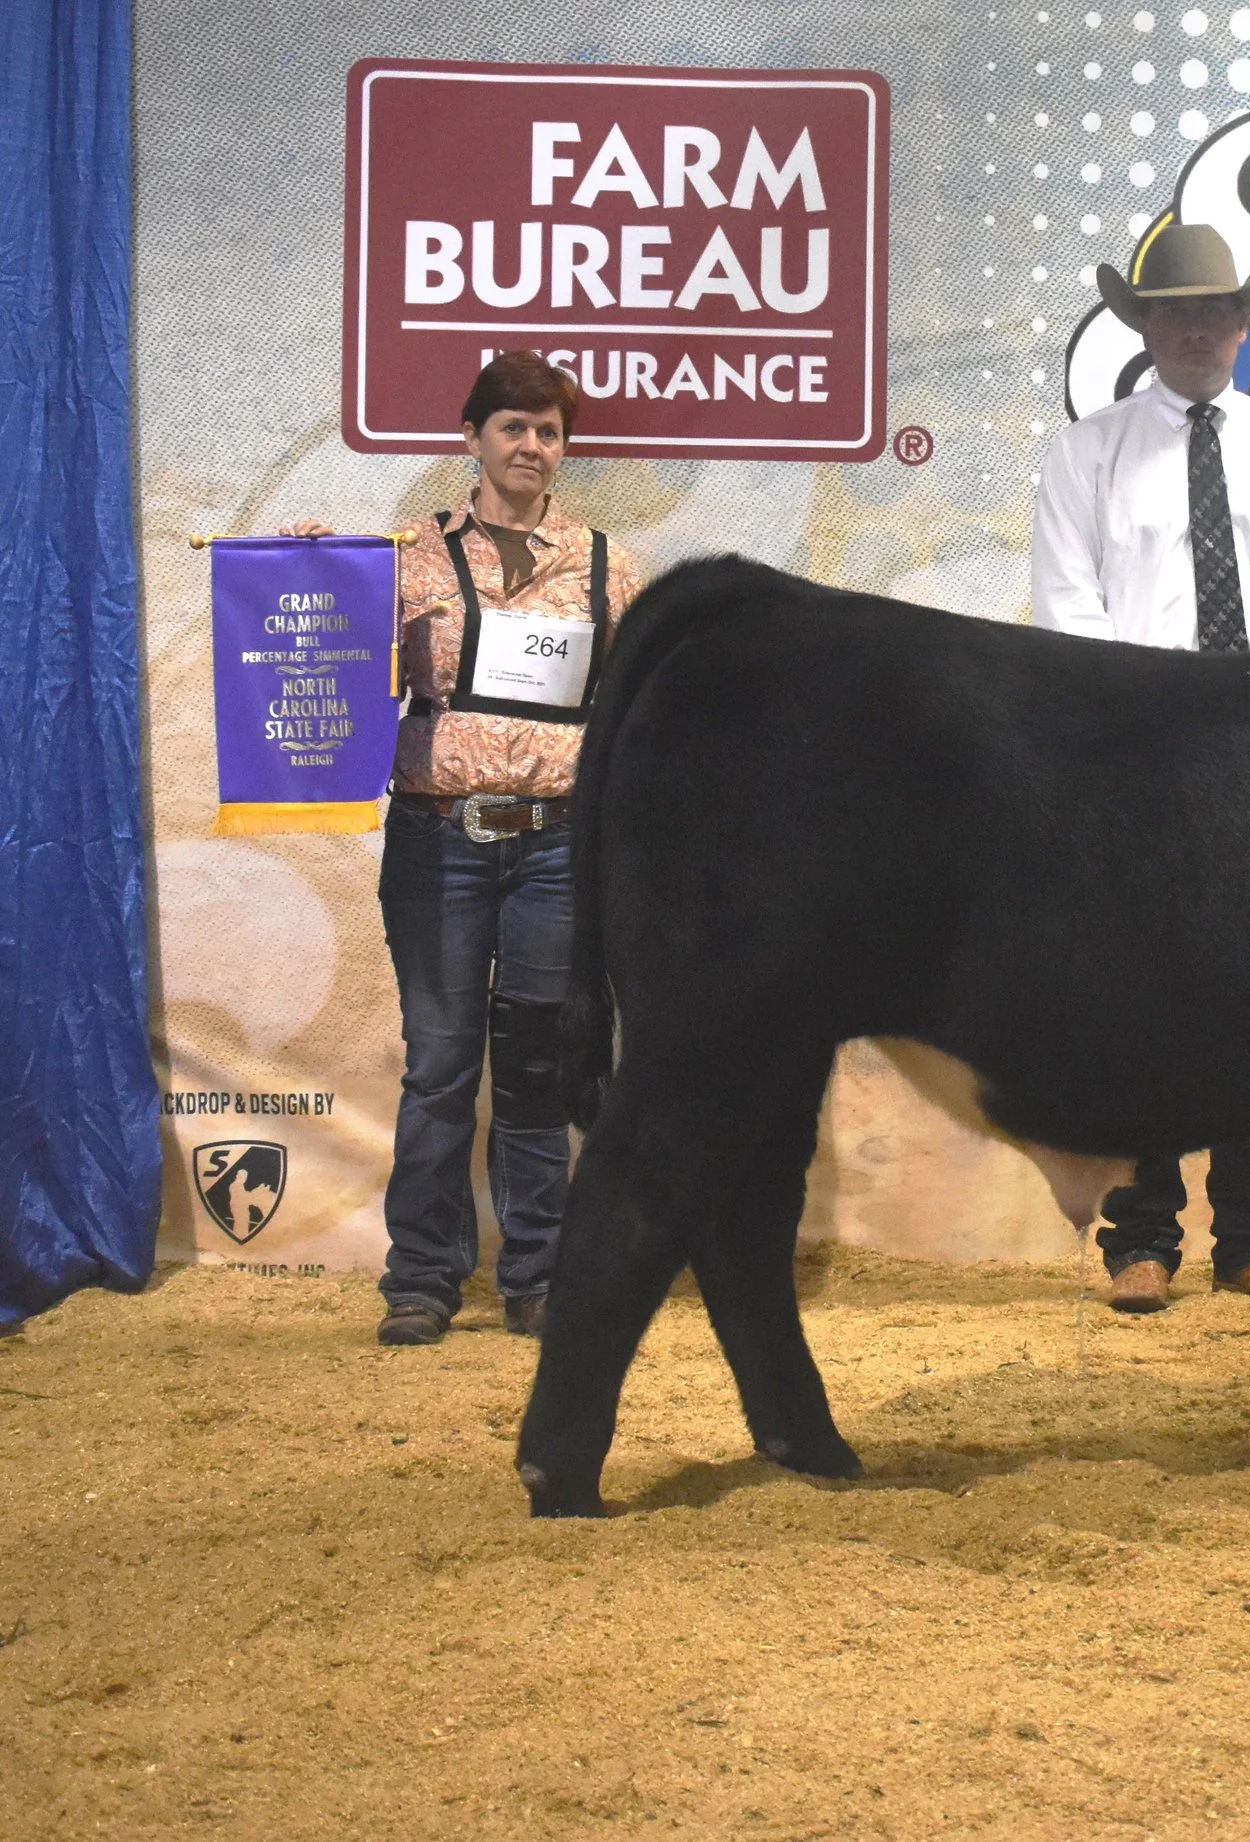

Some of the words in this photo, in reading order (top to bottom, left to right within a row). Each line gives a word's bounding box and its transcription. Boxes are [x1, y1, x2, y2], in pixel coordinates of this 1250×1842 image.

[531, 121, 827, 212] FARM
[404, 220, 831, 314] BUREAU
[279, 593, 335, 612] GRAND
[264, 614, 350, 634] CHAMPION
[295, 635, 321, 648] BULL
[524, 634, 568, 660] 264
[242, 651, 308, 663] PERCENTAGE
[313, 649, 373, 662] SIMMENTAL
[282, 678, 337, 697] NORTH
[269, 698, 349, 718] CAROLINA
[264, 719, 313, 740] STATE
[319, 719, 355, 738] FAIR
[290, 754, 334, 767] RALEIGH
[235, 1093, 245, 1114] &
[250, 1093, 309, 1115] DESIGN
[314, 1093, 334, 1115] BY
